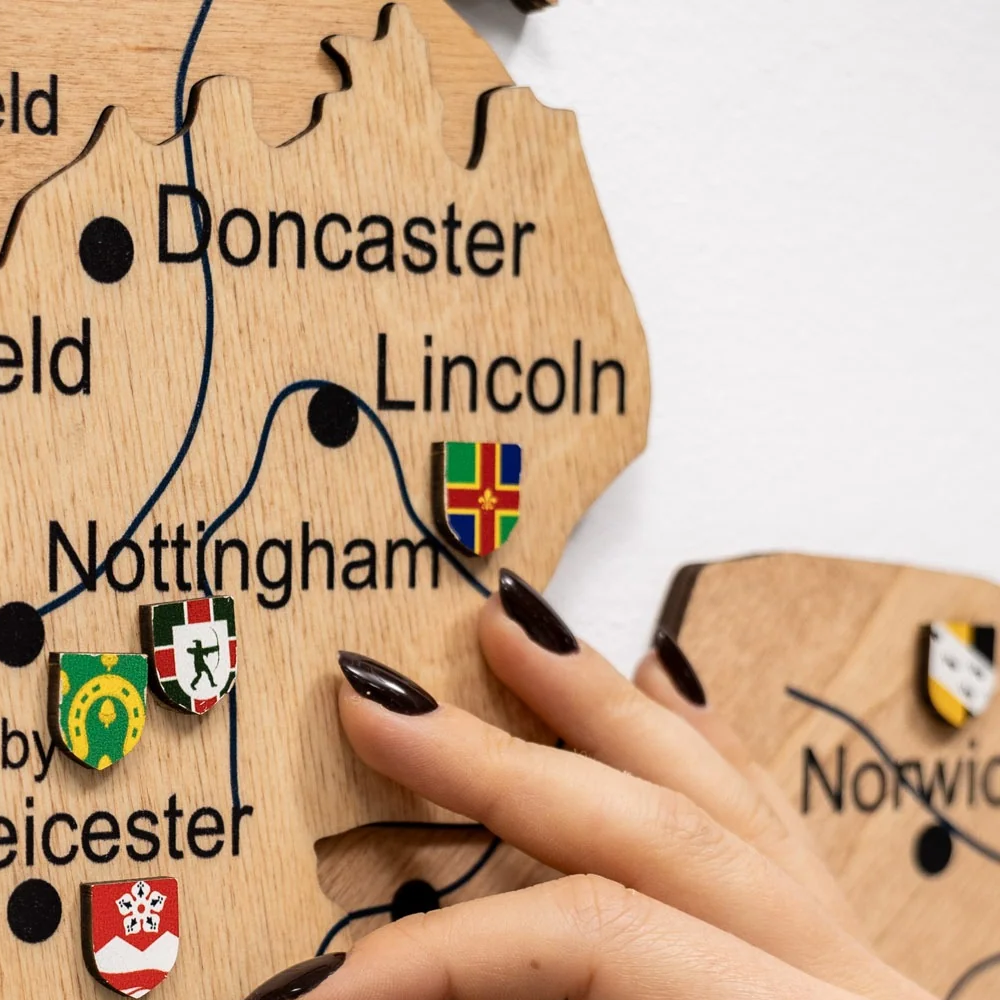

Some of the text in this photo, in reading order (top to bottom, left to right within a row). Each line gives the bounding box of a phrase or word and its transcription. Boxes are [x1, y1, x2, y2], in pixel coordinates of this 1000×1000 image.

[158, 184, 536, 279] Doncaster
[376, 333, 628, 415] Lincoln
[47, 520, 442, 610] Nottingham
